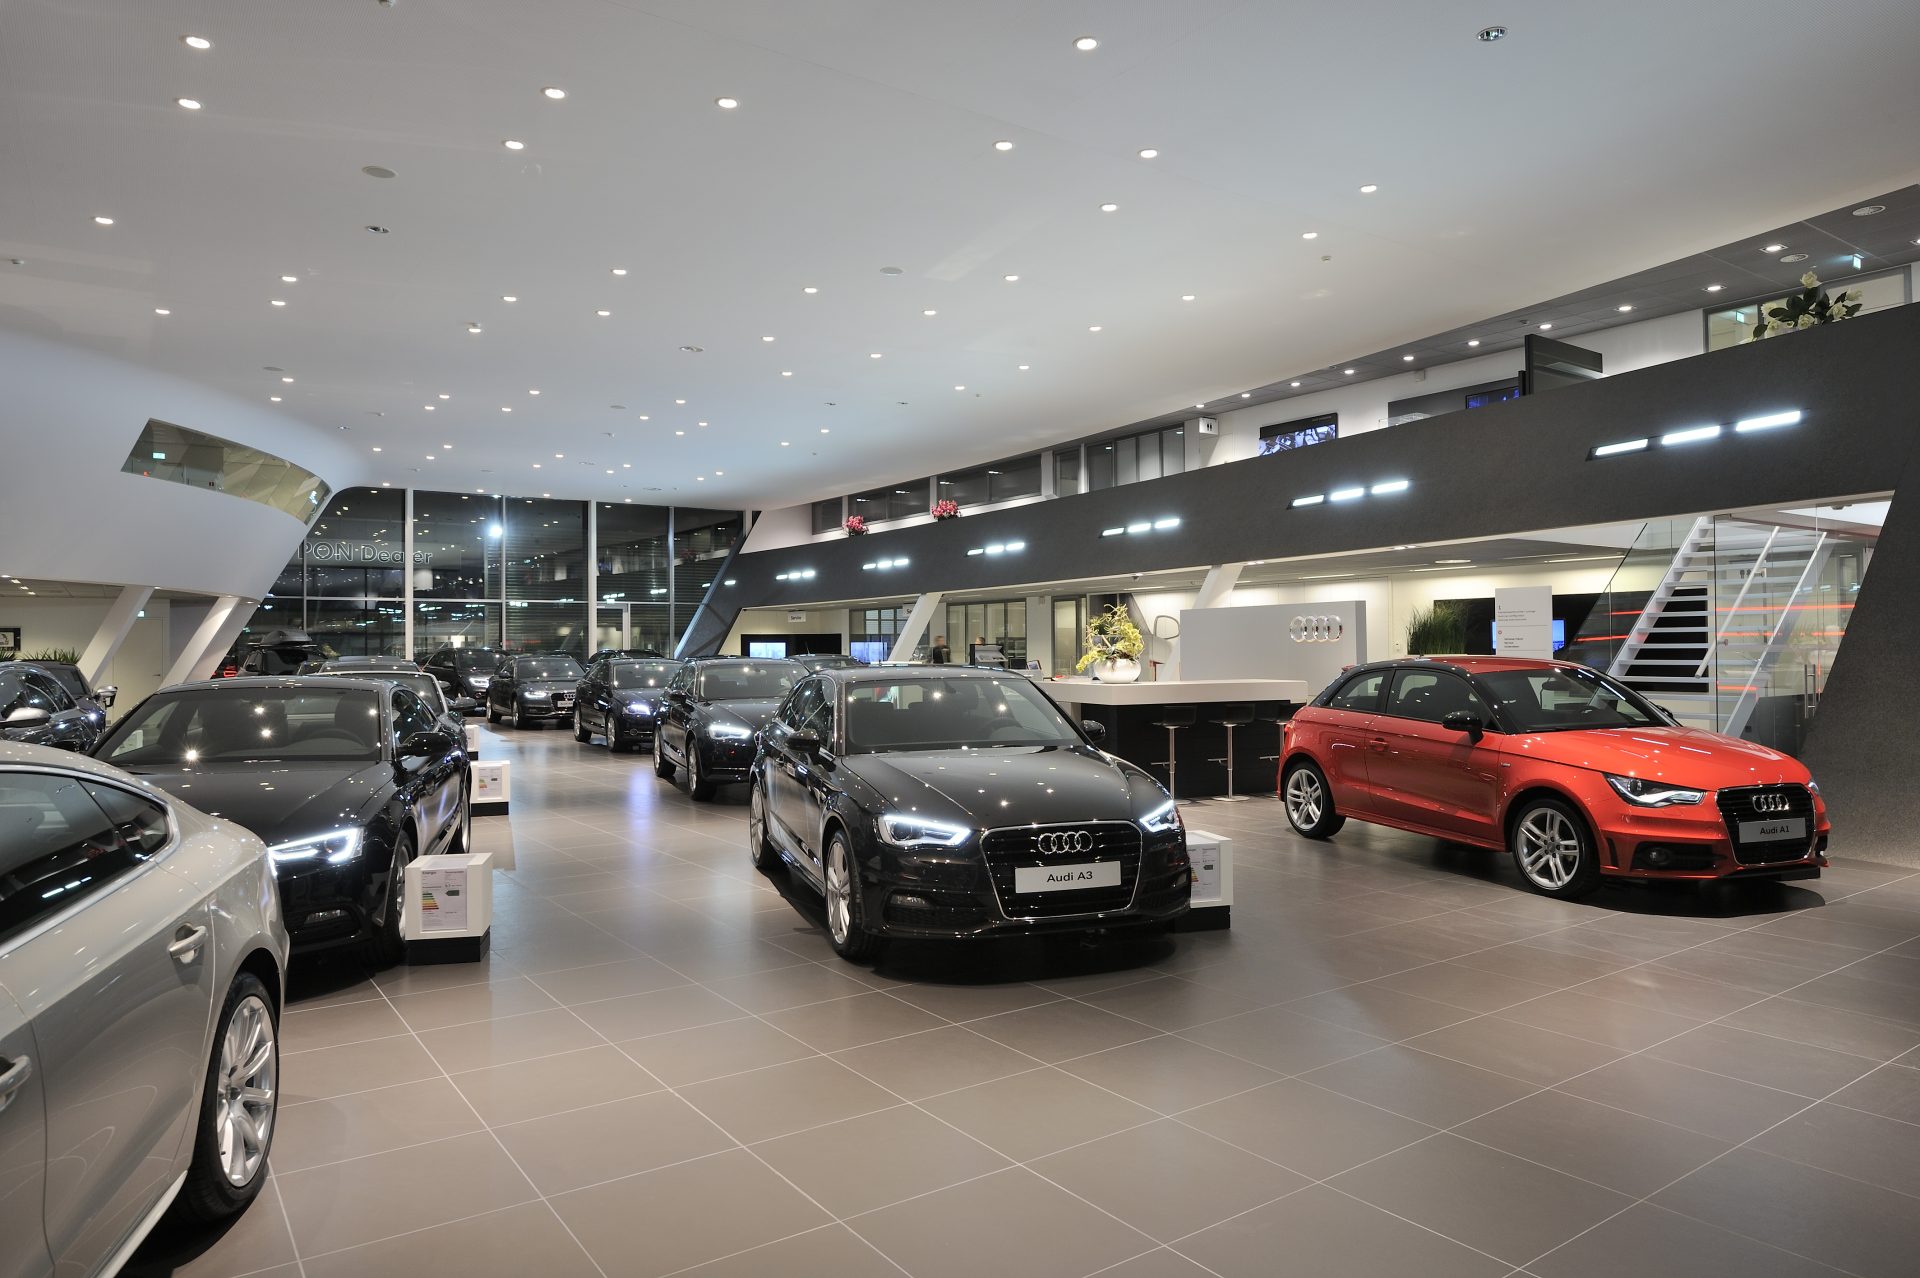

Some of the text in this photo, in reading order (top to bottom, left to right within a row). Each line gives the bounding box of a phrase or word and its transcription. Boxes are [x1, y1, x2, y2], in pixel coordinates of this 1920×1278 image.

[298, 541, 434, 565] PON Deaer
[1759, 825, 1790, 835] Audi A1
[1046, 870, 1093, 883] Audi A3
